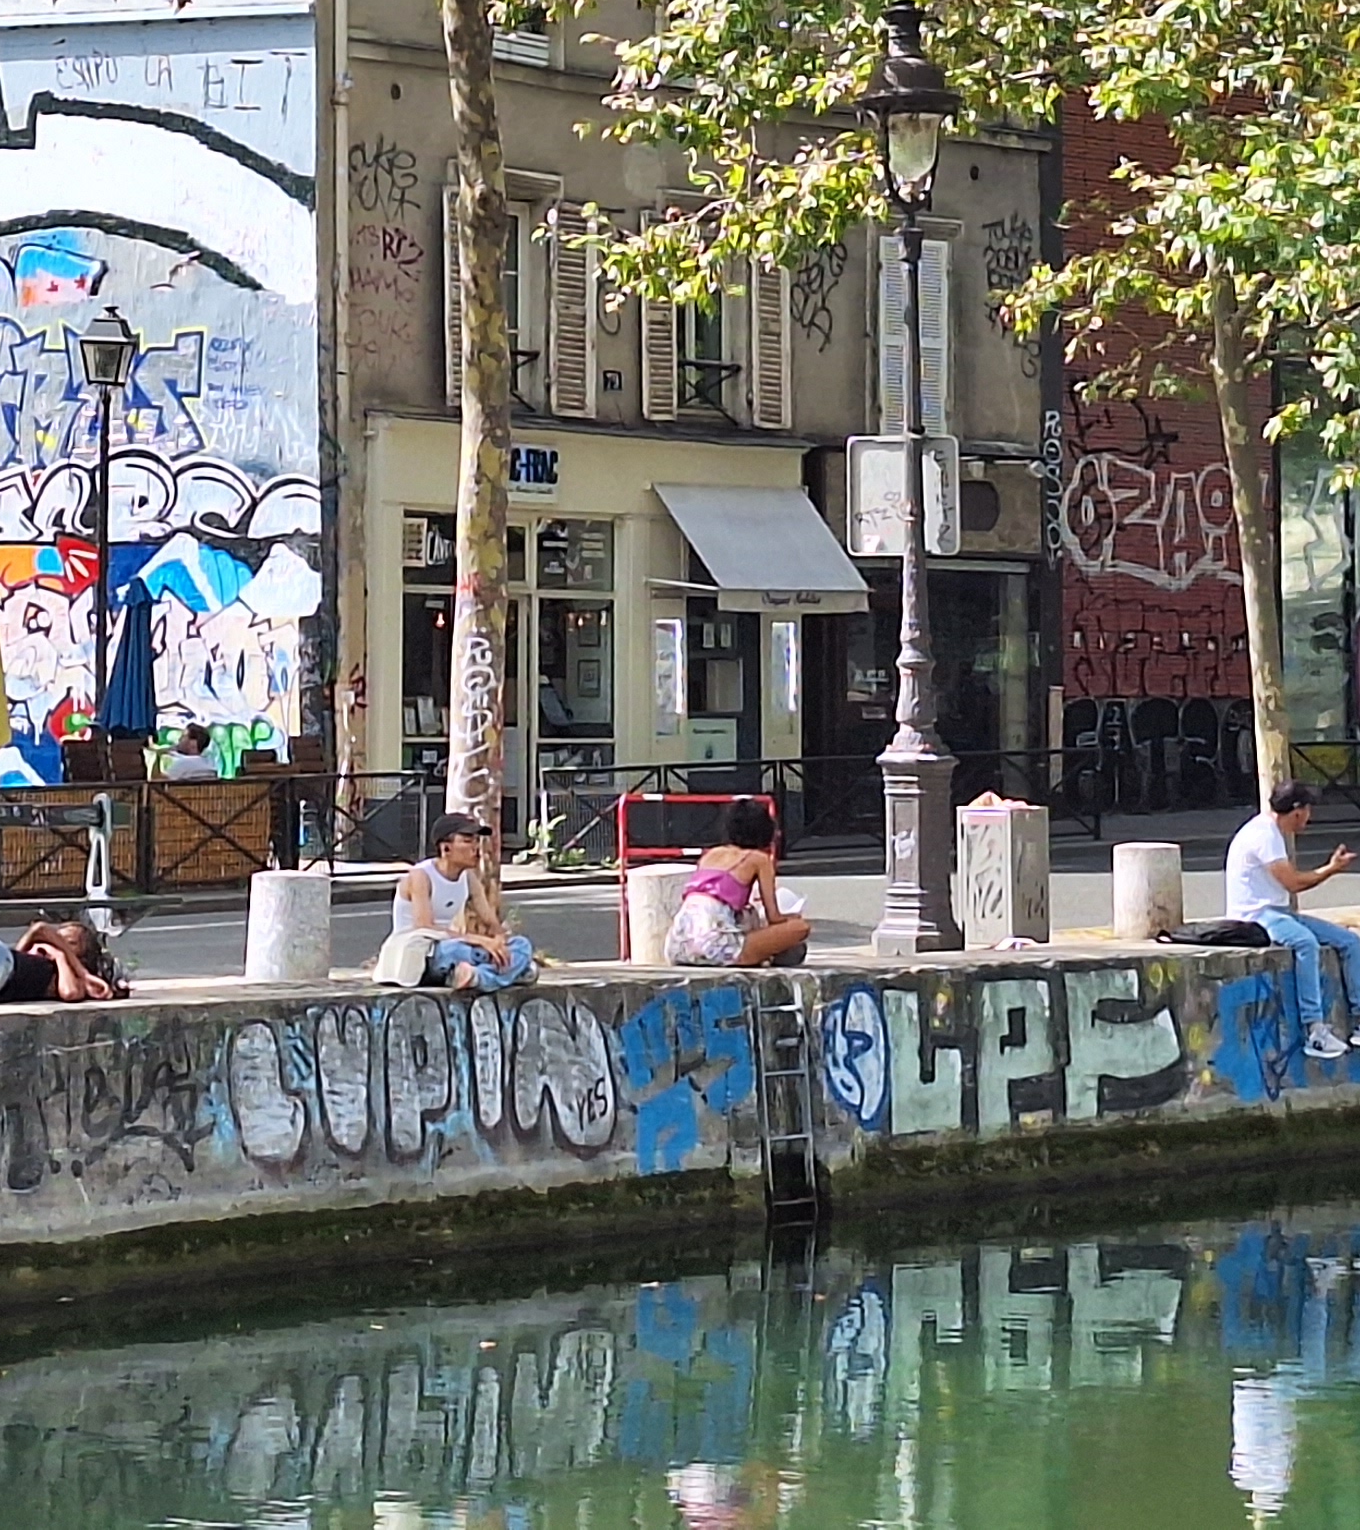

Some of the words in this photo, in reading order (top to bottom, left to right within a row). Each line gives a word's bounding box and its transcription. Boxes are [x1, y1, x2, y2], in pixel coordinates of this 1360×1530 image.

[508, 448, 559, 485] C-FRAC
[228, 993, 619, 1166] LUPIN
[576, 1075, 609, 1132] YES
